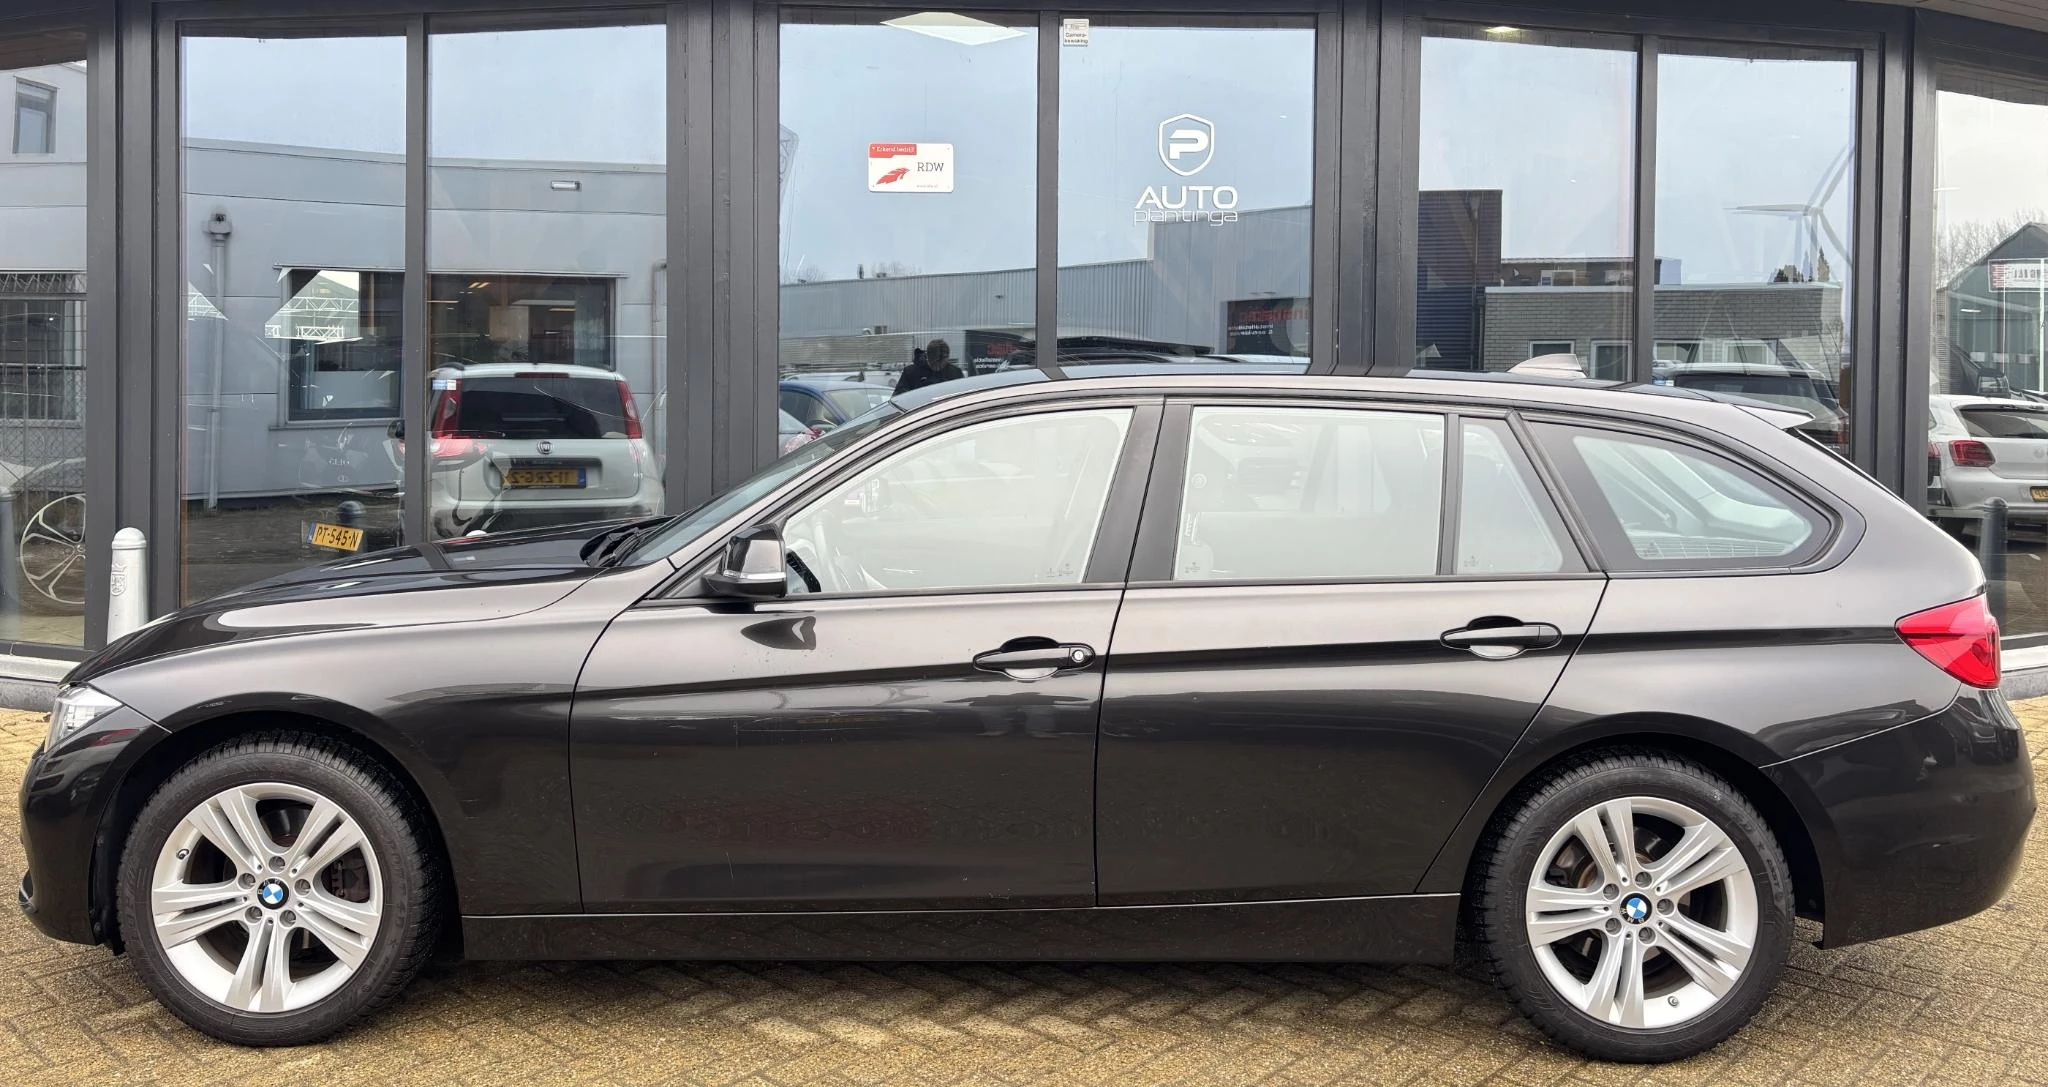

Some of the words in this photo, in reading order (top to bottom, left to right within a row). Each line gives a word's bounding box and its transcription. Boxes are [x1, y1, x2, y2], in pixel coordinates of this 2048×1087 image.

[917, 162, 945, 172] RDW
[1134, 185, 1239, 210] AUTO
[1133, 207, 1239, 227] plantinga
[314, 526, 360, 548] PT-545-N
